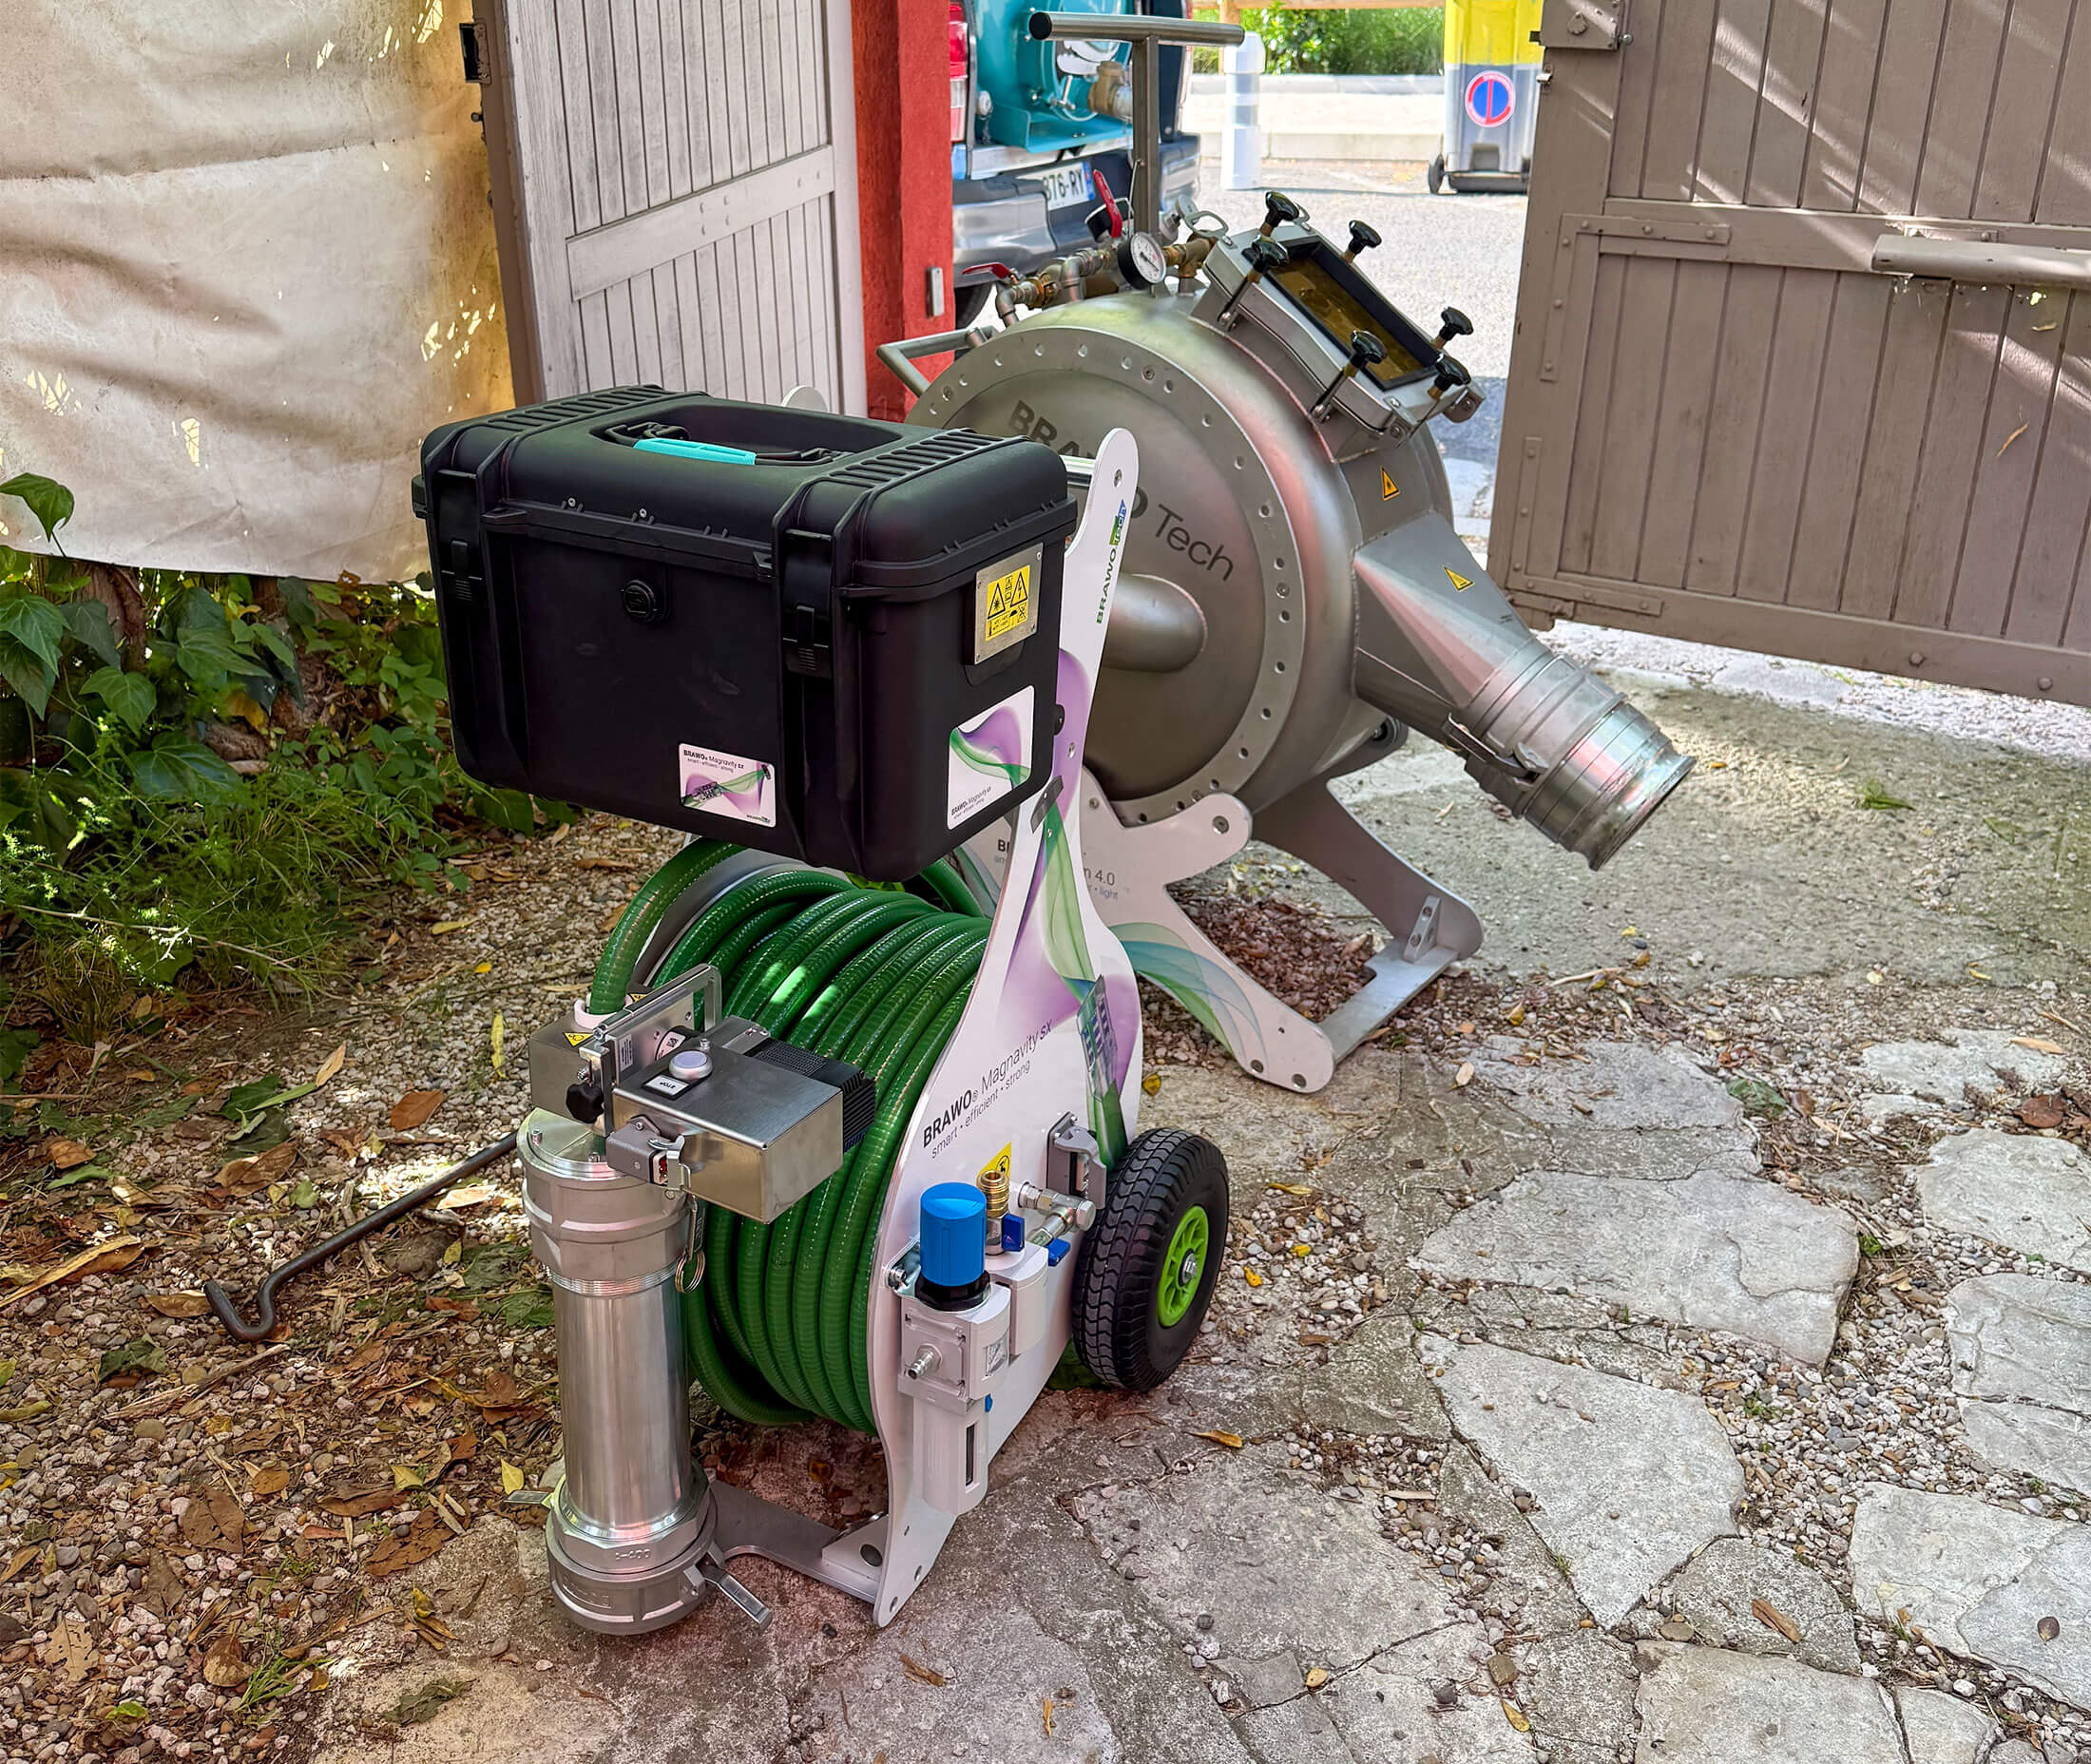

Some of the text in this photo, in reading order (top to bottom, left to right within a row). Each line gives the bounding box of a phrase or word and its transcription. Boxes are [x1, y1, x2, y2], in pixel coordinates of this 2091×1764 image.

[1155, 503, 1234, 583] Tech
[1096, 547, 1117, 624] BRAWO
[981, 1030, 1039, 1095] Magnavity
[931, 1060, 1031, 1159] smart efficient strong
